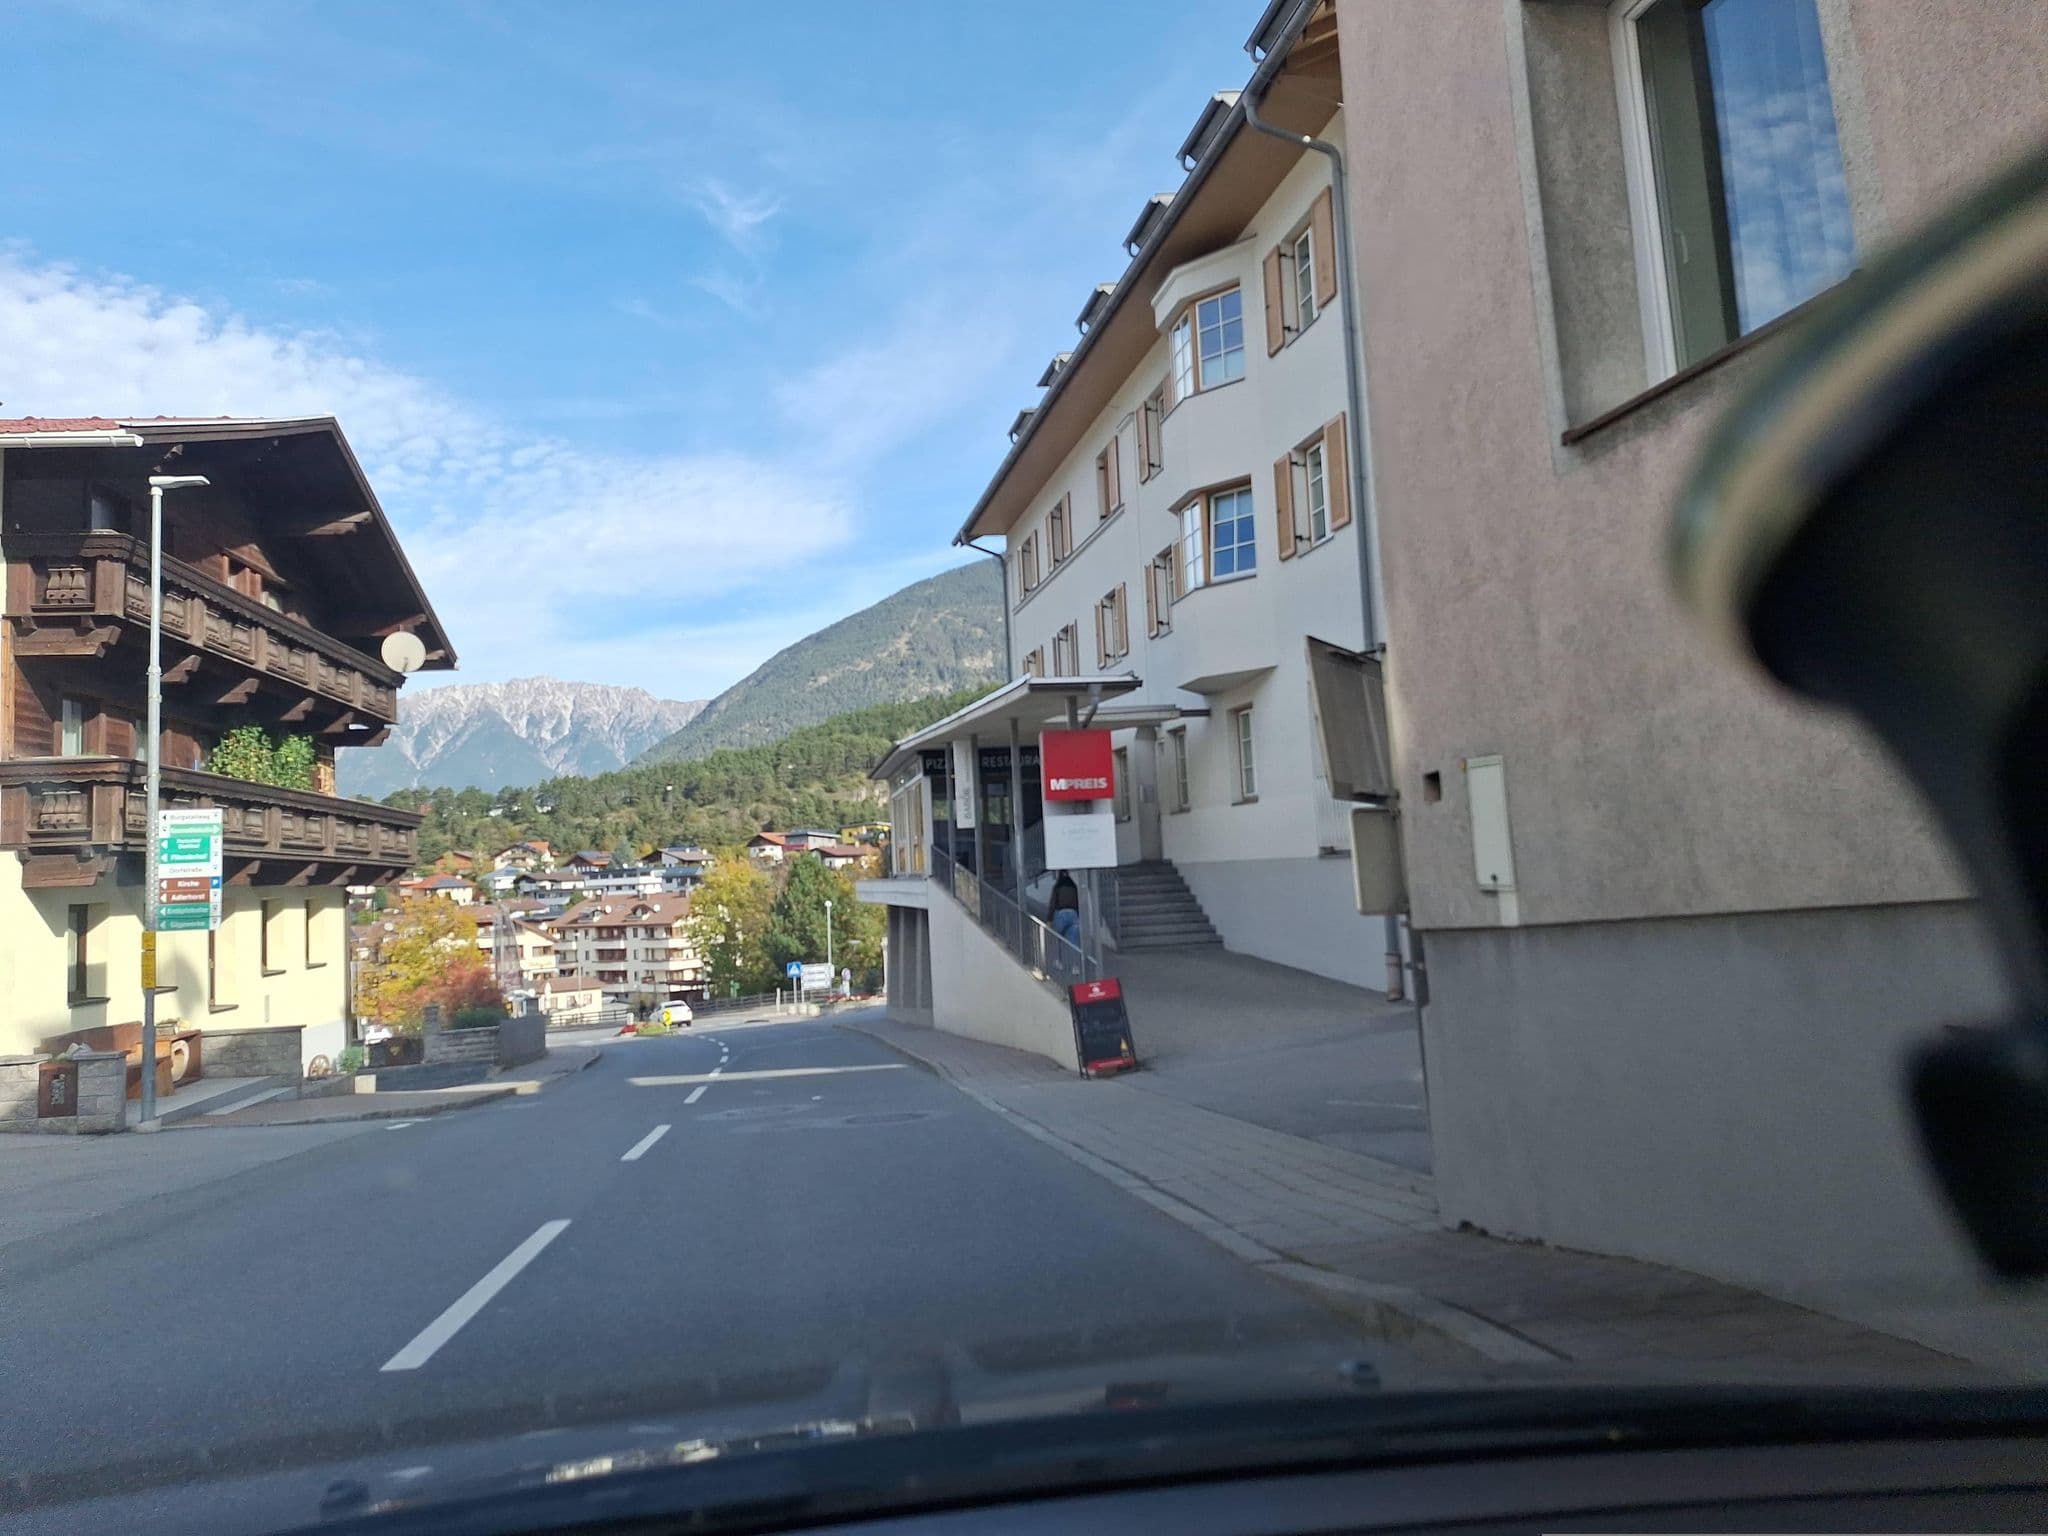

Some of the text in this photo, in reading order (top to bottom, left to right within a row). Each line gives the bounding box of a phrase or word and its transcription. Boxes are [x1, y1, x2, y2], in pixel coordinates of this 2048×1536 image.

[1050, 777, 1108, 791] MPREIS
[177, 880, 200, 888] Kirche
[171, 893, 206, 901] Adlerhorst
